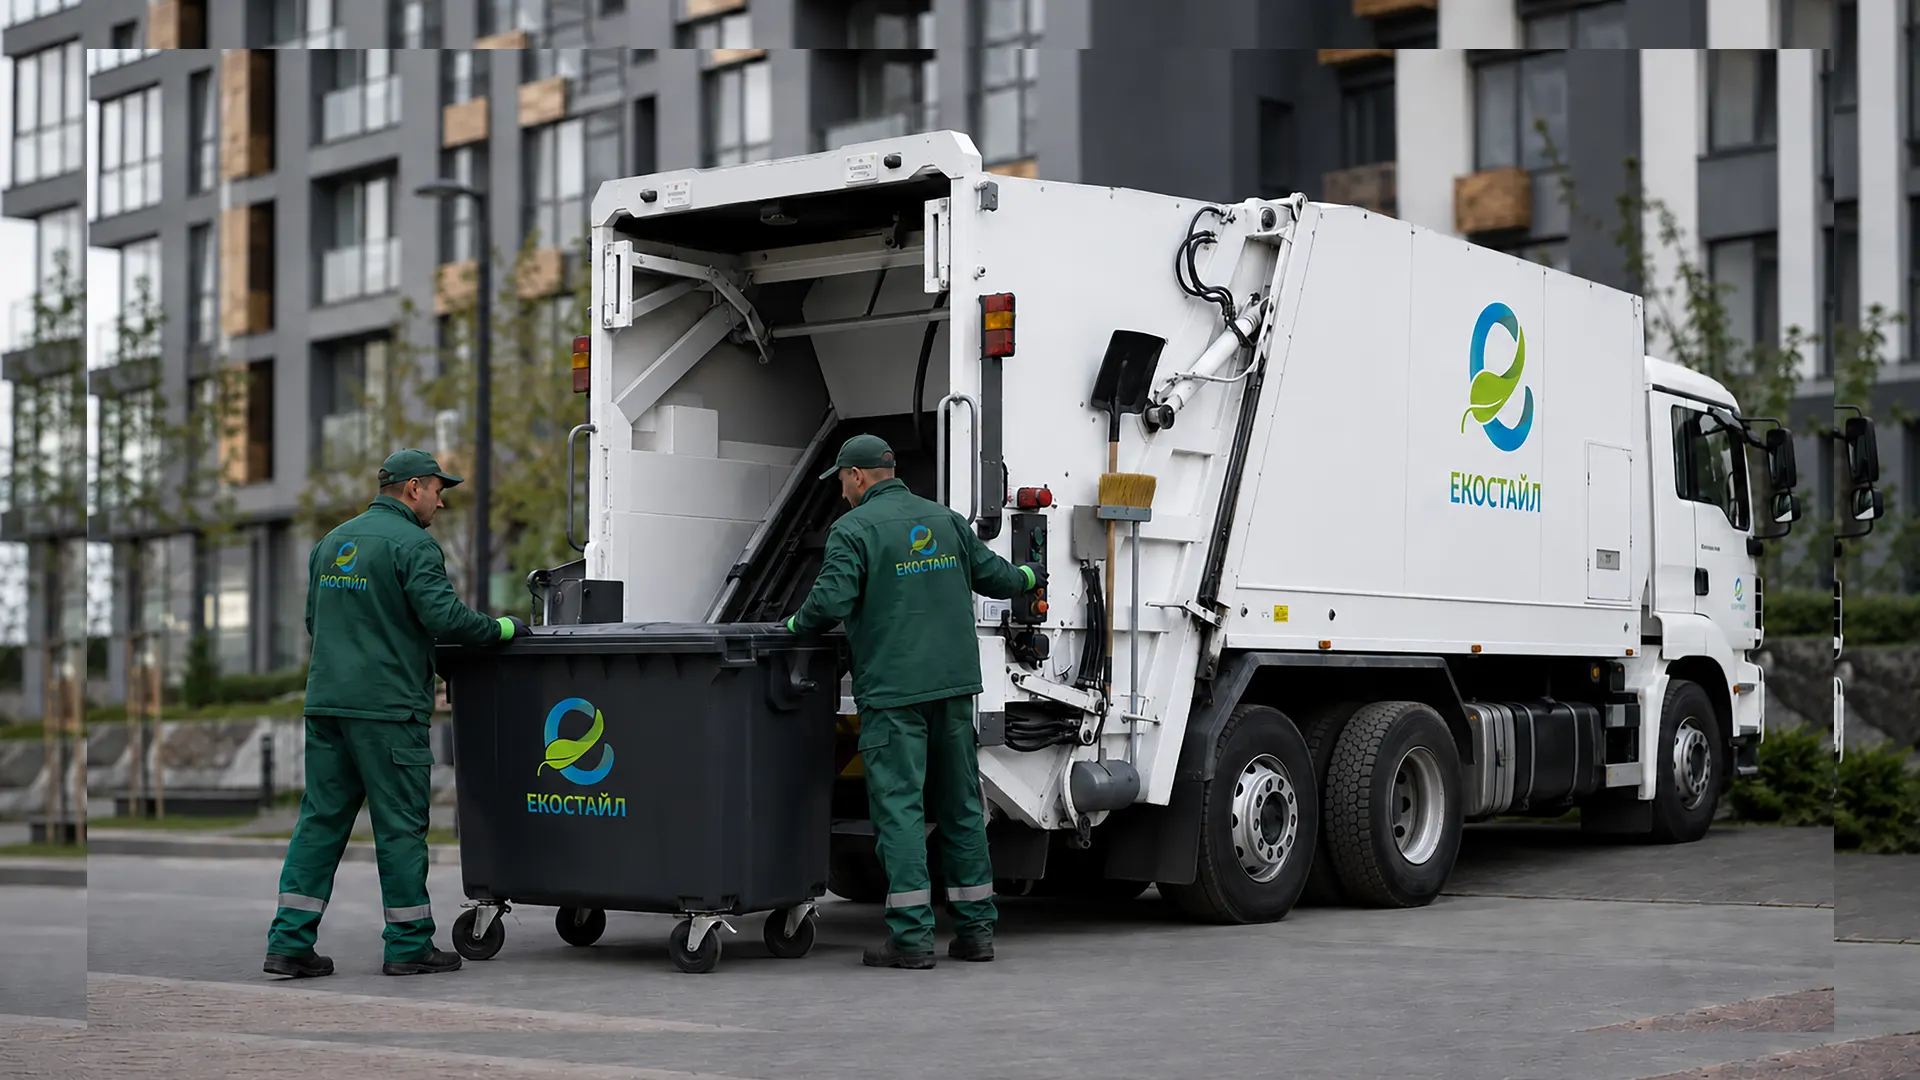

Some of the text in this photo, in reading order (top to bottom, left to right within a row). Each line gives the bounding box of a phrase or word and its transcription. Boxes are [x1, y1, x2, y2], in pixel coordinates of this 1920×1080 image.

[1450, 471, 1541, 513] ЕКОСТАЙЛ
[895, 554, 957, 576] ЕКОСТАЙЛ
[527, 792, 626, 817] ЕКОСТАЙЛ
